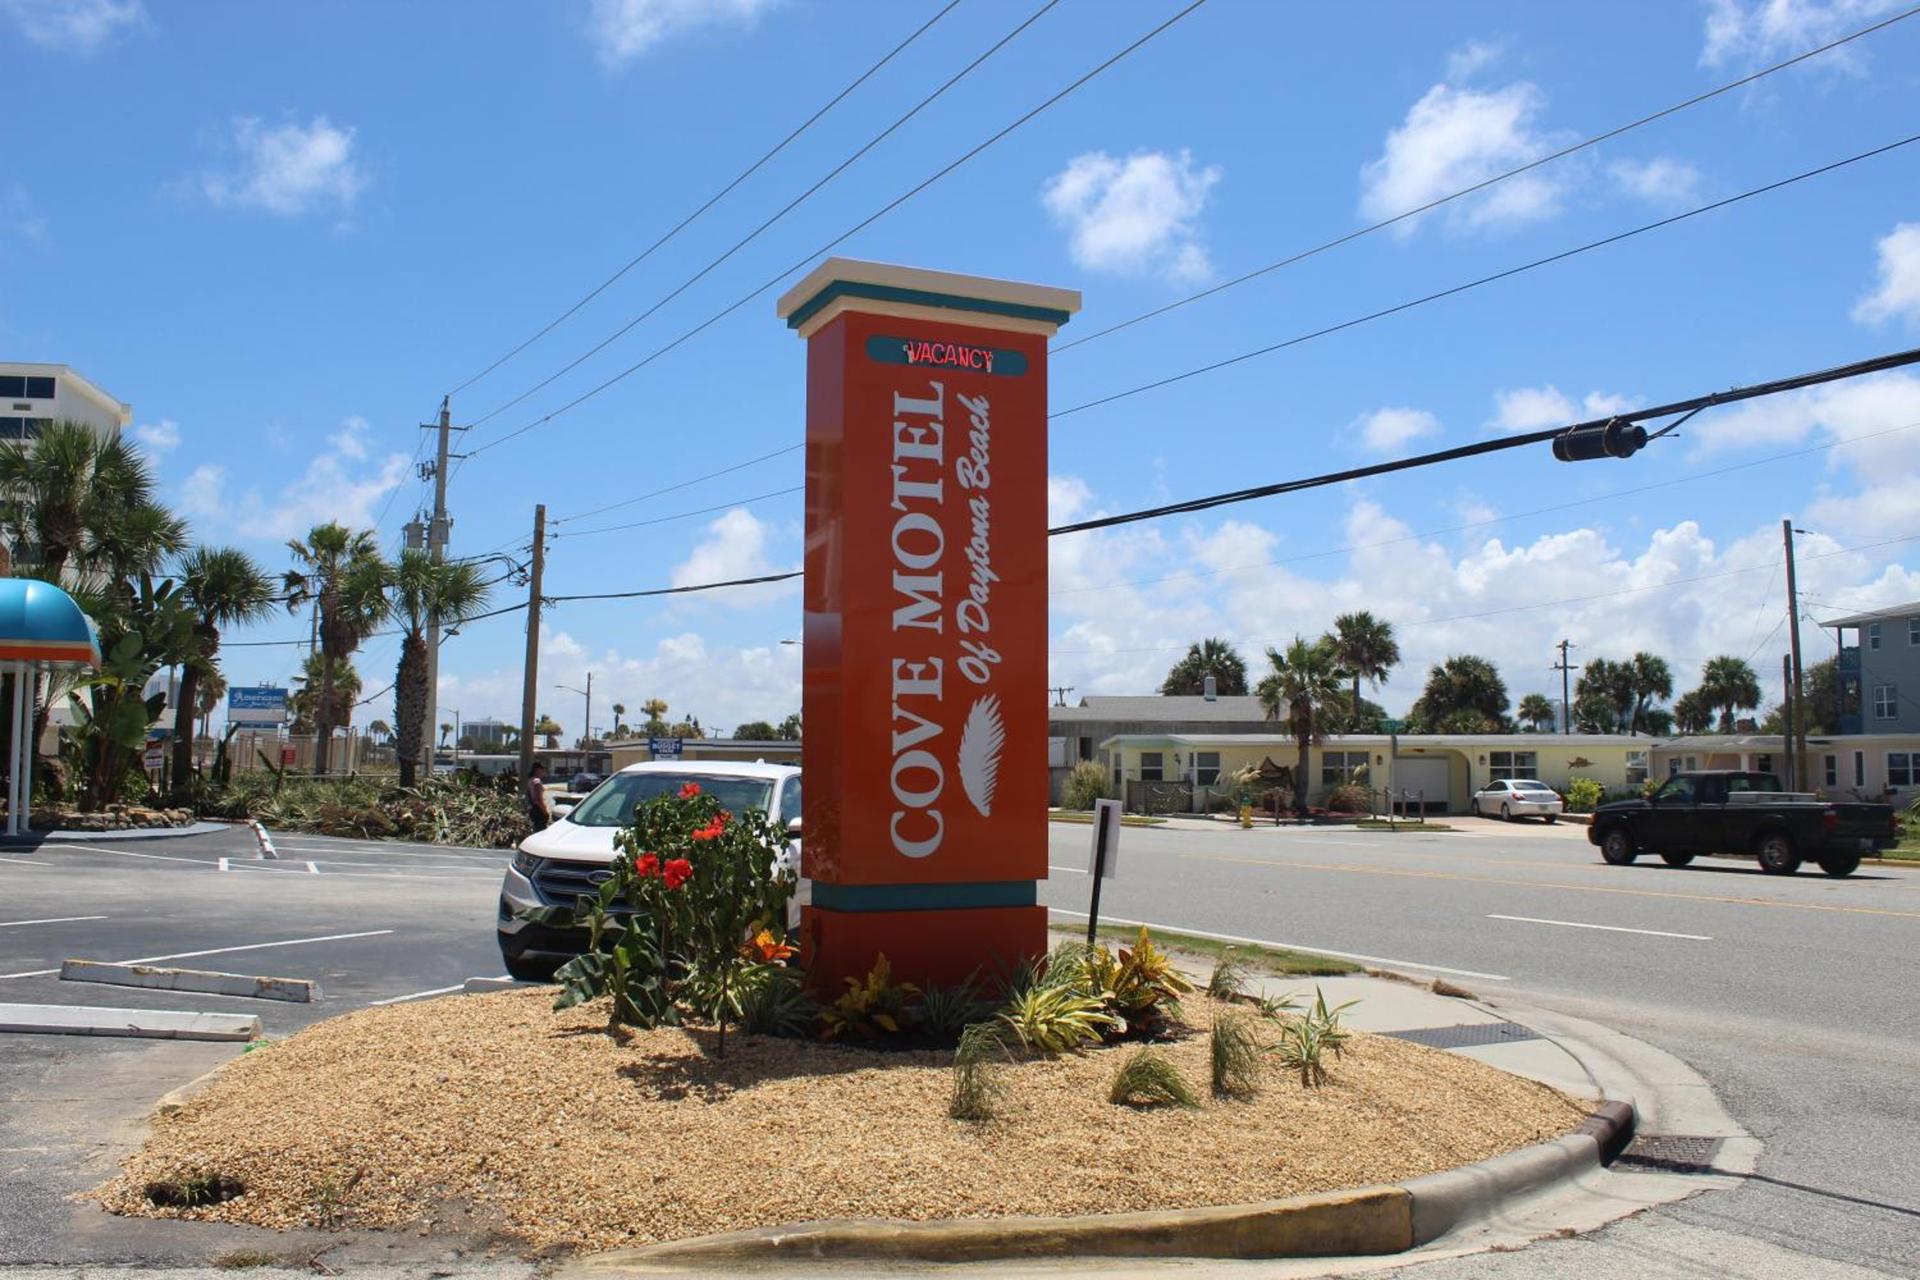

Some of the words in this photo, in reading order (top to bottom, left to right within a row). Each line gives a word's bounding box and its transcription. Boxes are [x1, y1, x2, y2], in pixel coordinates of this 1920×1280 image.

[908, 341, 992, 370] VACANCY
[957, 393, 990, 489] Beach
[891, 381, 944, 634] MOTEL
[957, 496, 1000, 633] Daytona
[957, 640, 1002, 684] Of
[890, 657, 944, 858] COVE
